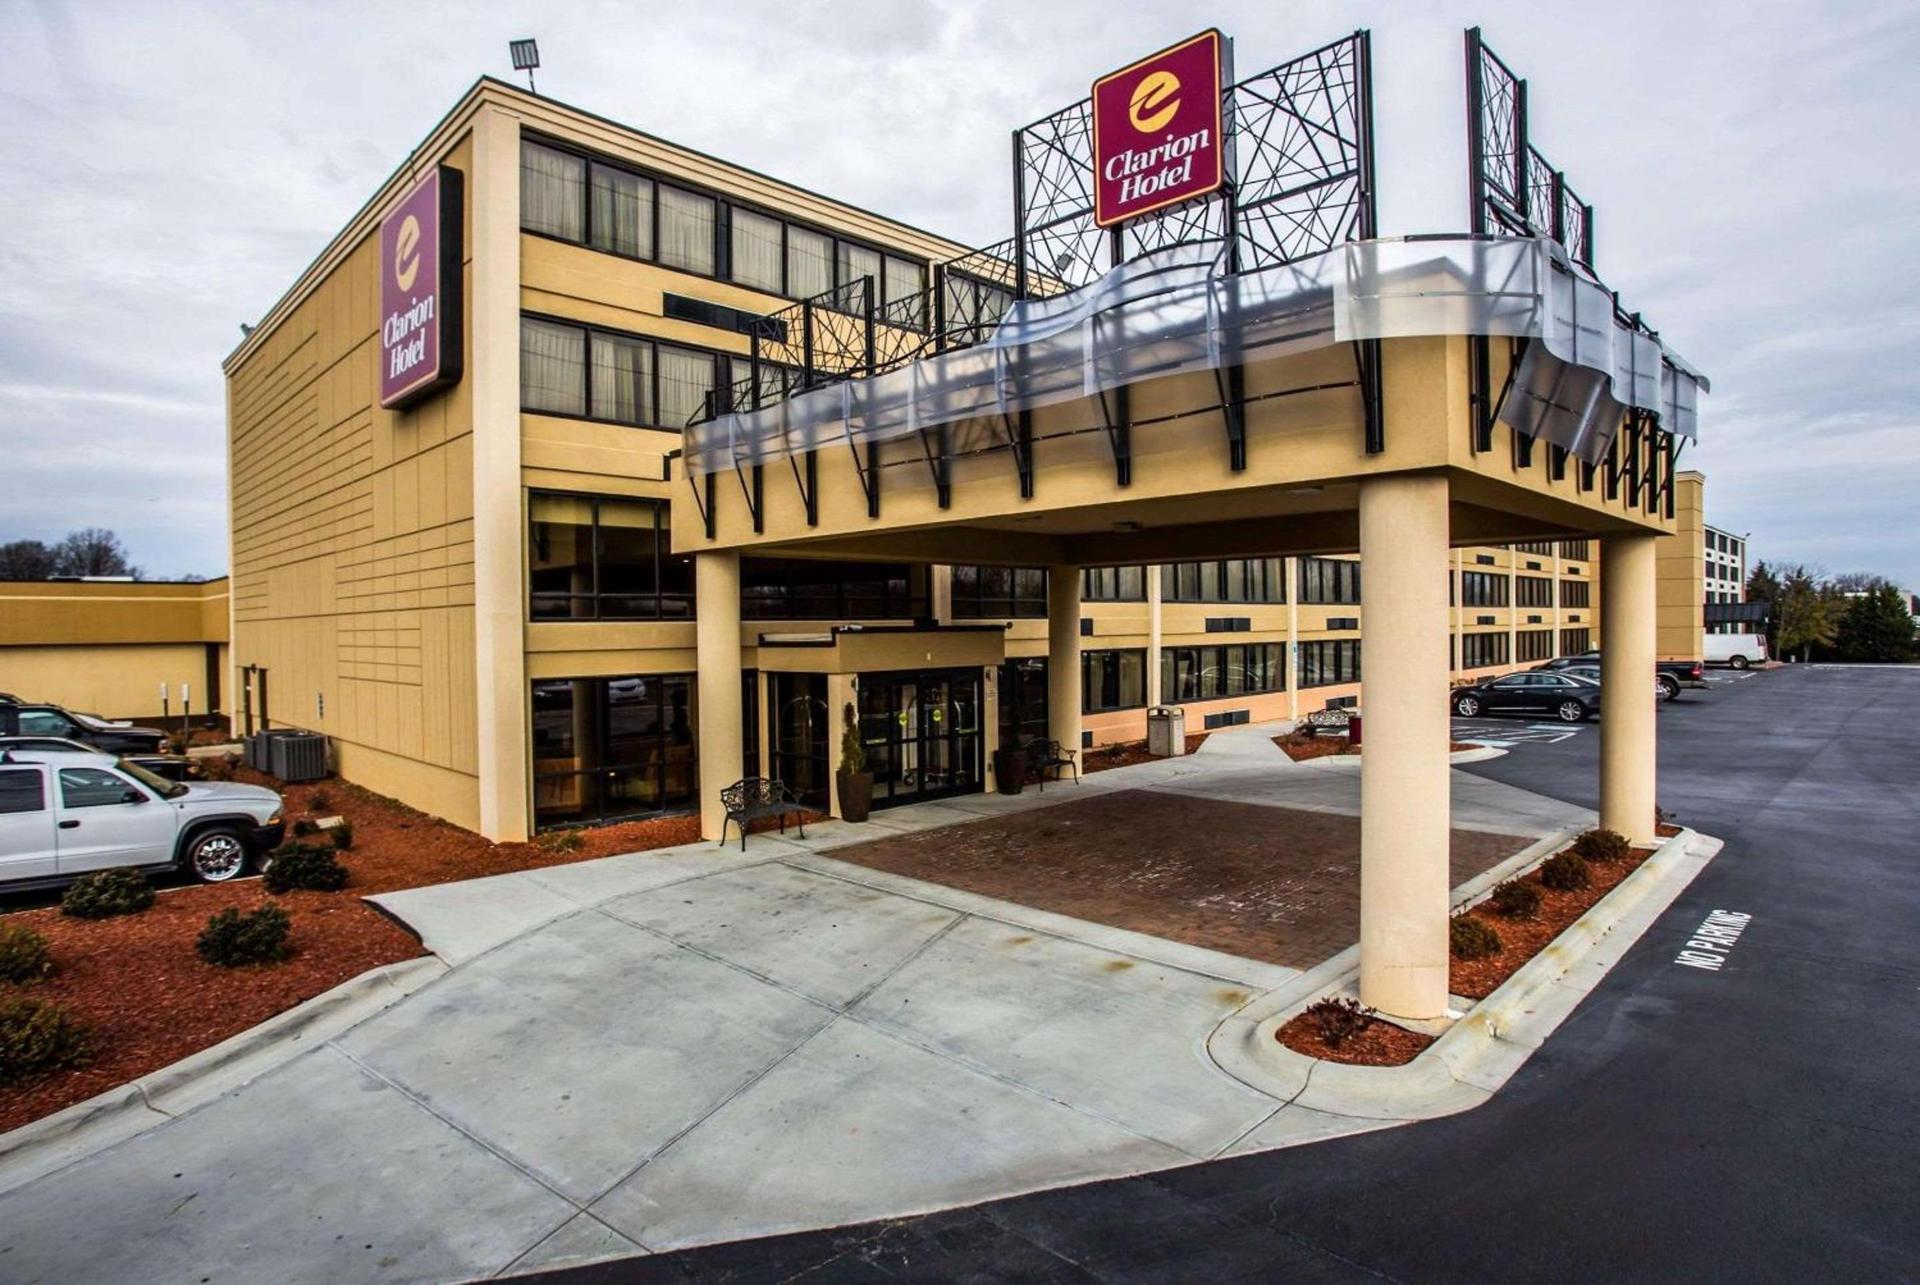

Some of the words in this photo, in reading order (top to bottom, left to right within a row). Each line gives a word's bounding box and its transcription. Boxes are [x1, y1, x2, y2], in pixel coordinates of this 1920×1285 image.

[1105, 128, 1210, 182] Clarion
[1118, 155, 1193, 205] Hotel
[383, 295, 434, 349] Clarion
[389, 328, 425, 379] Hotel
[1685, 909, 1752, 953] PARKING
[1674, 950, 1726, 971] NO
